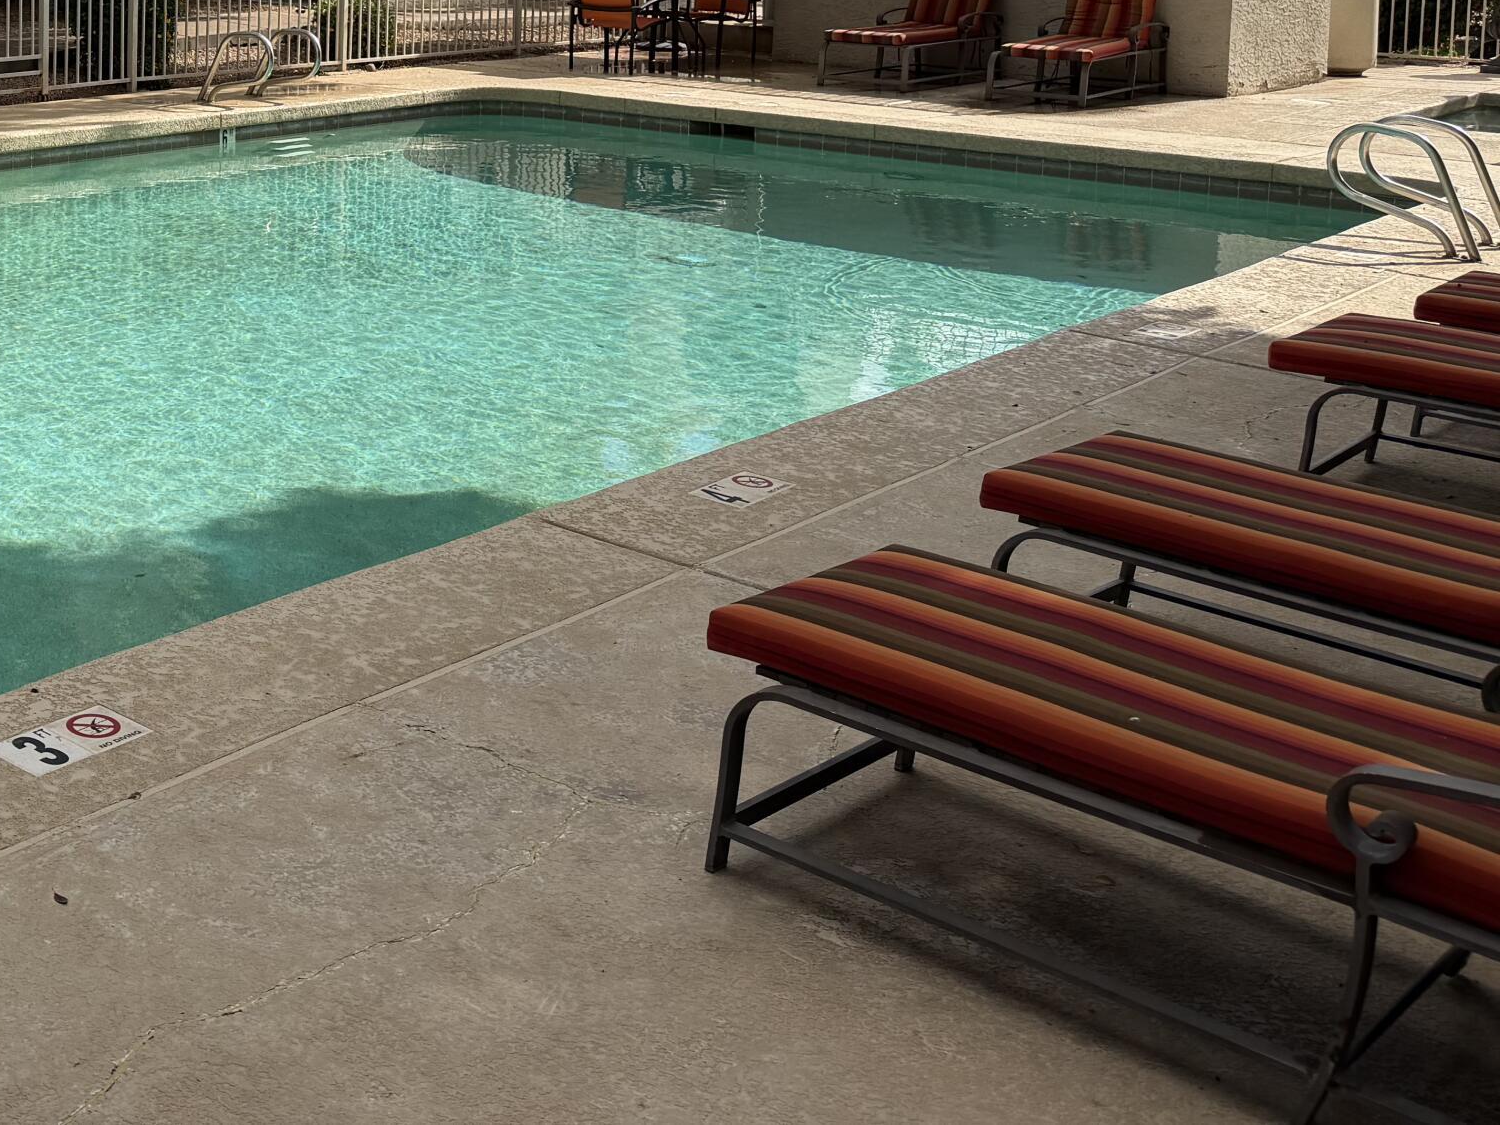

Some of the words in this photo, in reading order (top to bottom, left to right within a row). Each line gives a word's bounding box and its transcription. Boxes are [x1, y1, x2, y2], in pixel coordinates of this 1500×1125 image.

[700, 488, 751, 504] 4
[32, 728, 52, 739] FT
[98, 741, 113, 749] NO
[112, 730, 142, 743] DIVING
[11, 736, 70, 766] 3
